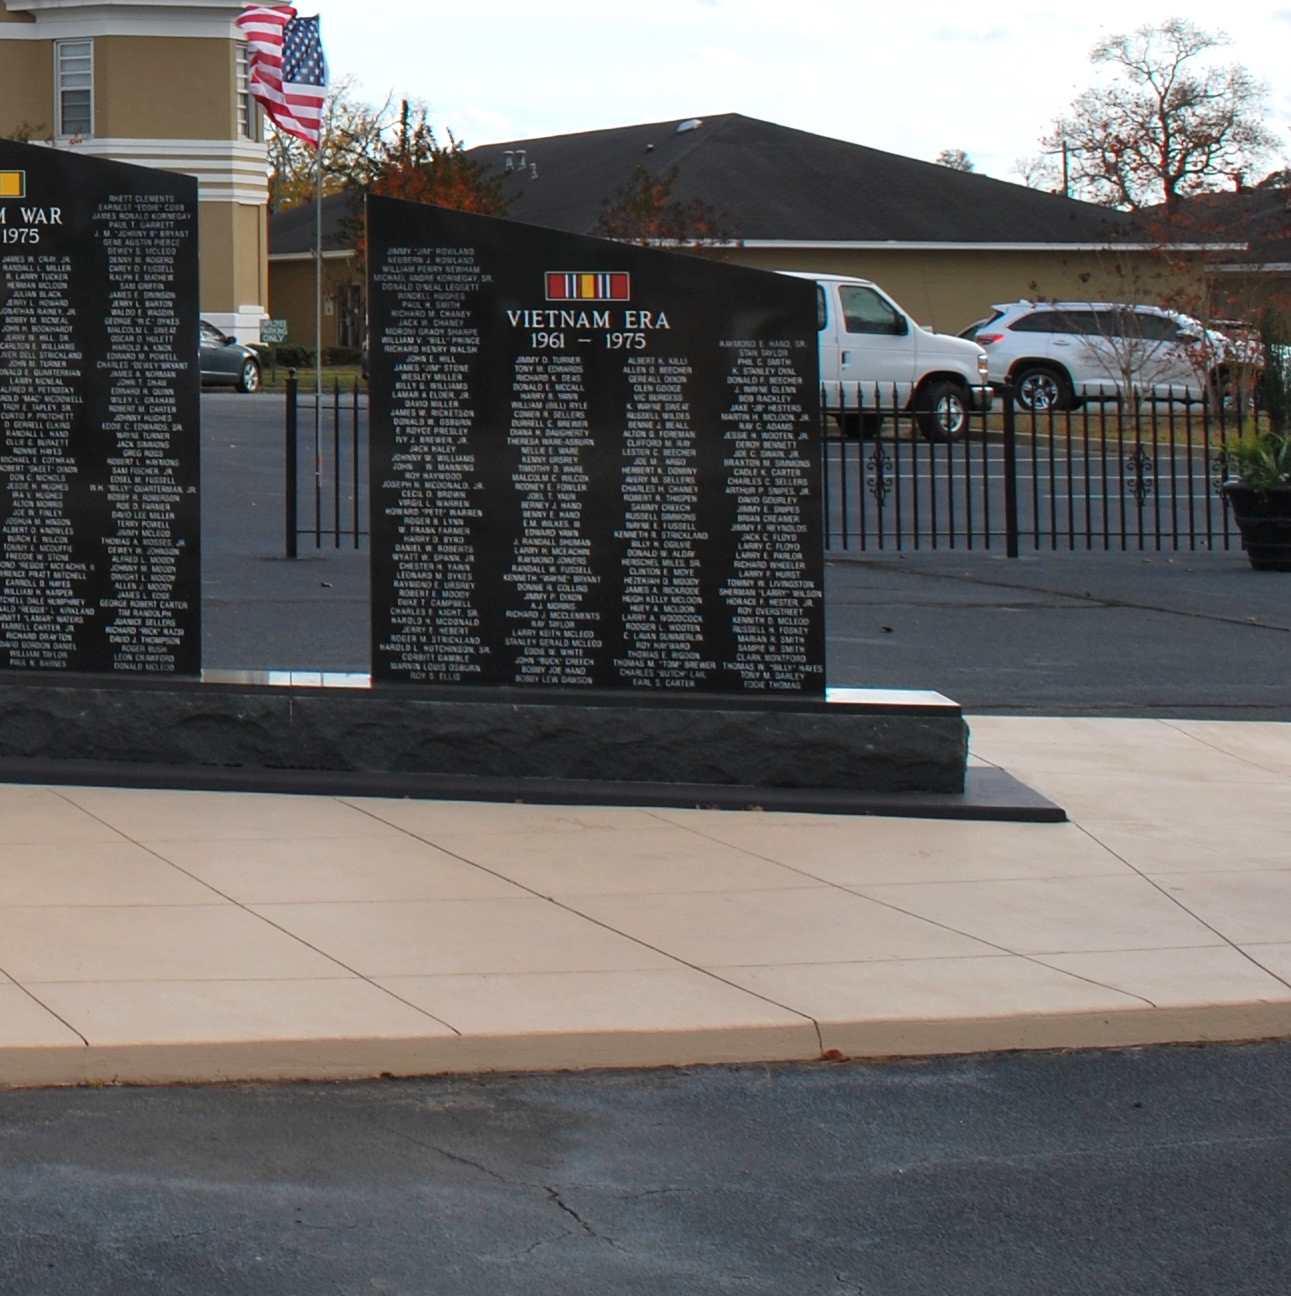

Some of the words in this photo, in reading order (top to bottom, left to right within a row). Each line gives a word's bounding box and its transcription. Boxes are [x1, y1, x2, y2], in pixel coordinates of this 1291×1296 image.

[20, 207, 62, 224] WAR
[2, 228, 39, 243] 1975
[506, 309, 610, 328] VIETNAM
[624, 310, 670, 329] ERA
[531, 331, 564, 348] 1961
[605, 332, 646, 349] 1975
